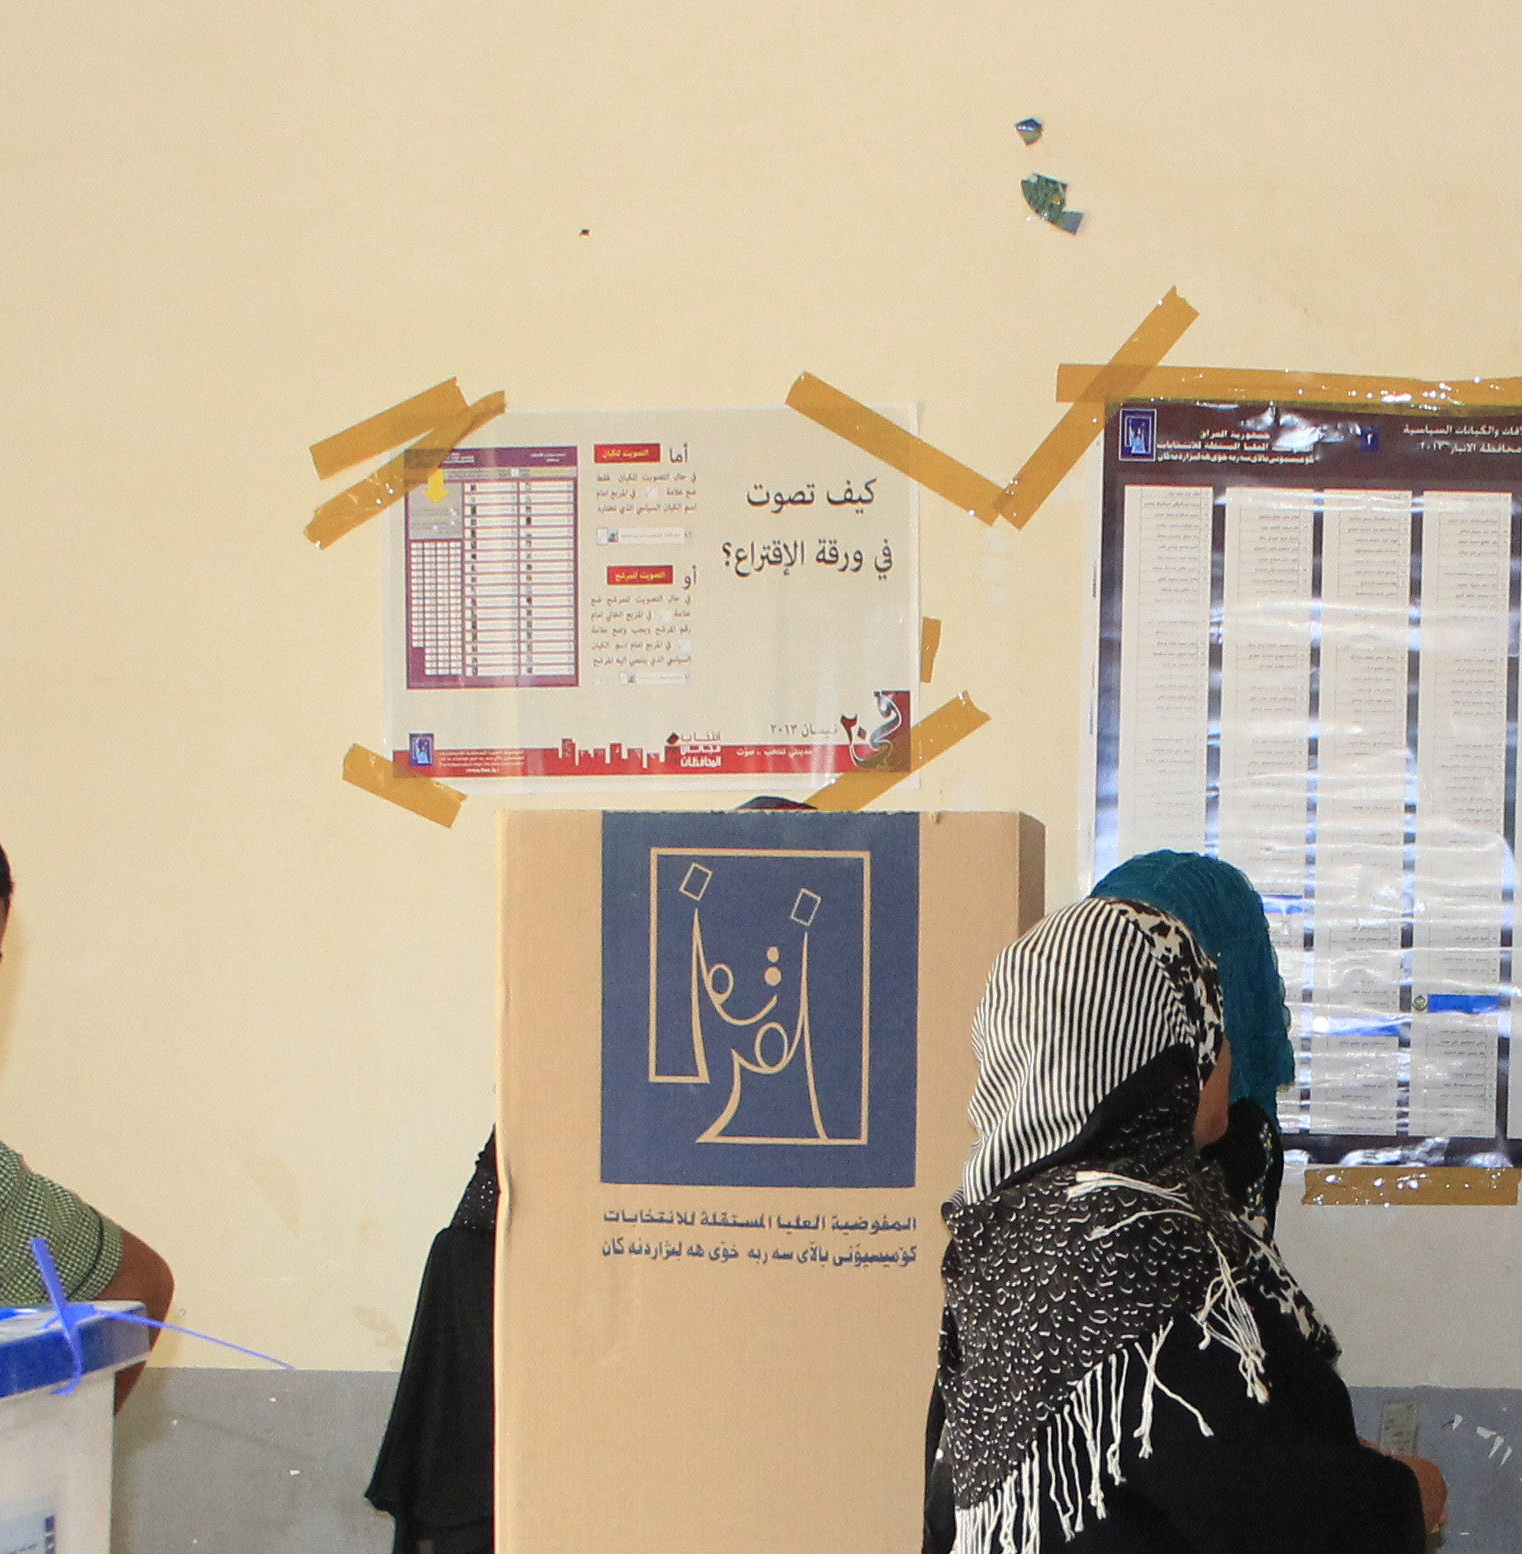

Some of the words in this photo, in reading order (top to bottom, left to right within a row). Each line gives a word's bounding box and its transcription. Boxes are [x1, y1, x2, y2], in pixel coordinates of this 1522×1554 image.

[669, 442, 688, 463] أما
[747, 483, 815, 514] تصوت
[827, 478, 877, 514] كيف
[722, 540, 805, 578] الإقتراع؟
[815, 538, 864, 573] ورقة
[874, 537, 894, 581] في
[682, 564, 697, 590] أو
[771, 723, 797, 735] ٢٠١٣
[801, 724, 838, 740] نيسان
[604, 1209, 696, 1227] للانتخابات
[700, 1211, 772, 1229] المستقلة
[777, 1213, 826, 1235] العليا
[831, 1214, 917, 1235] المفوضية
